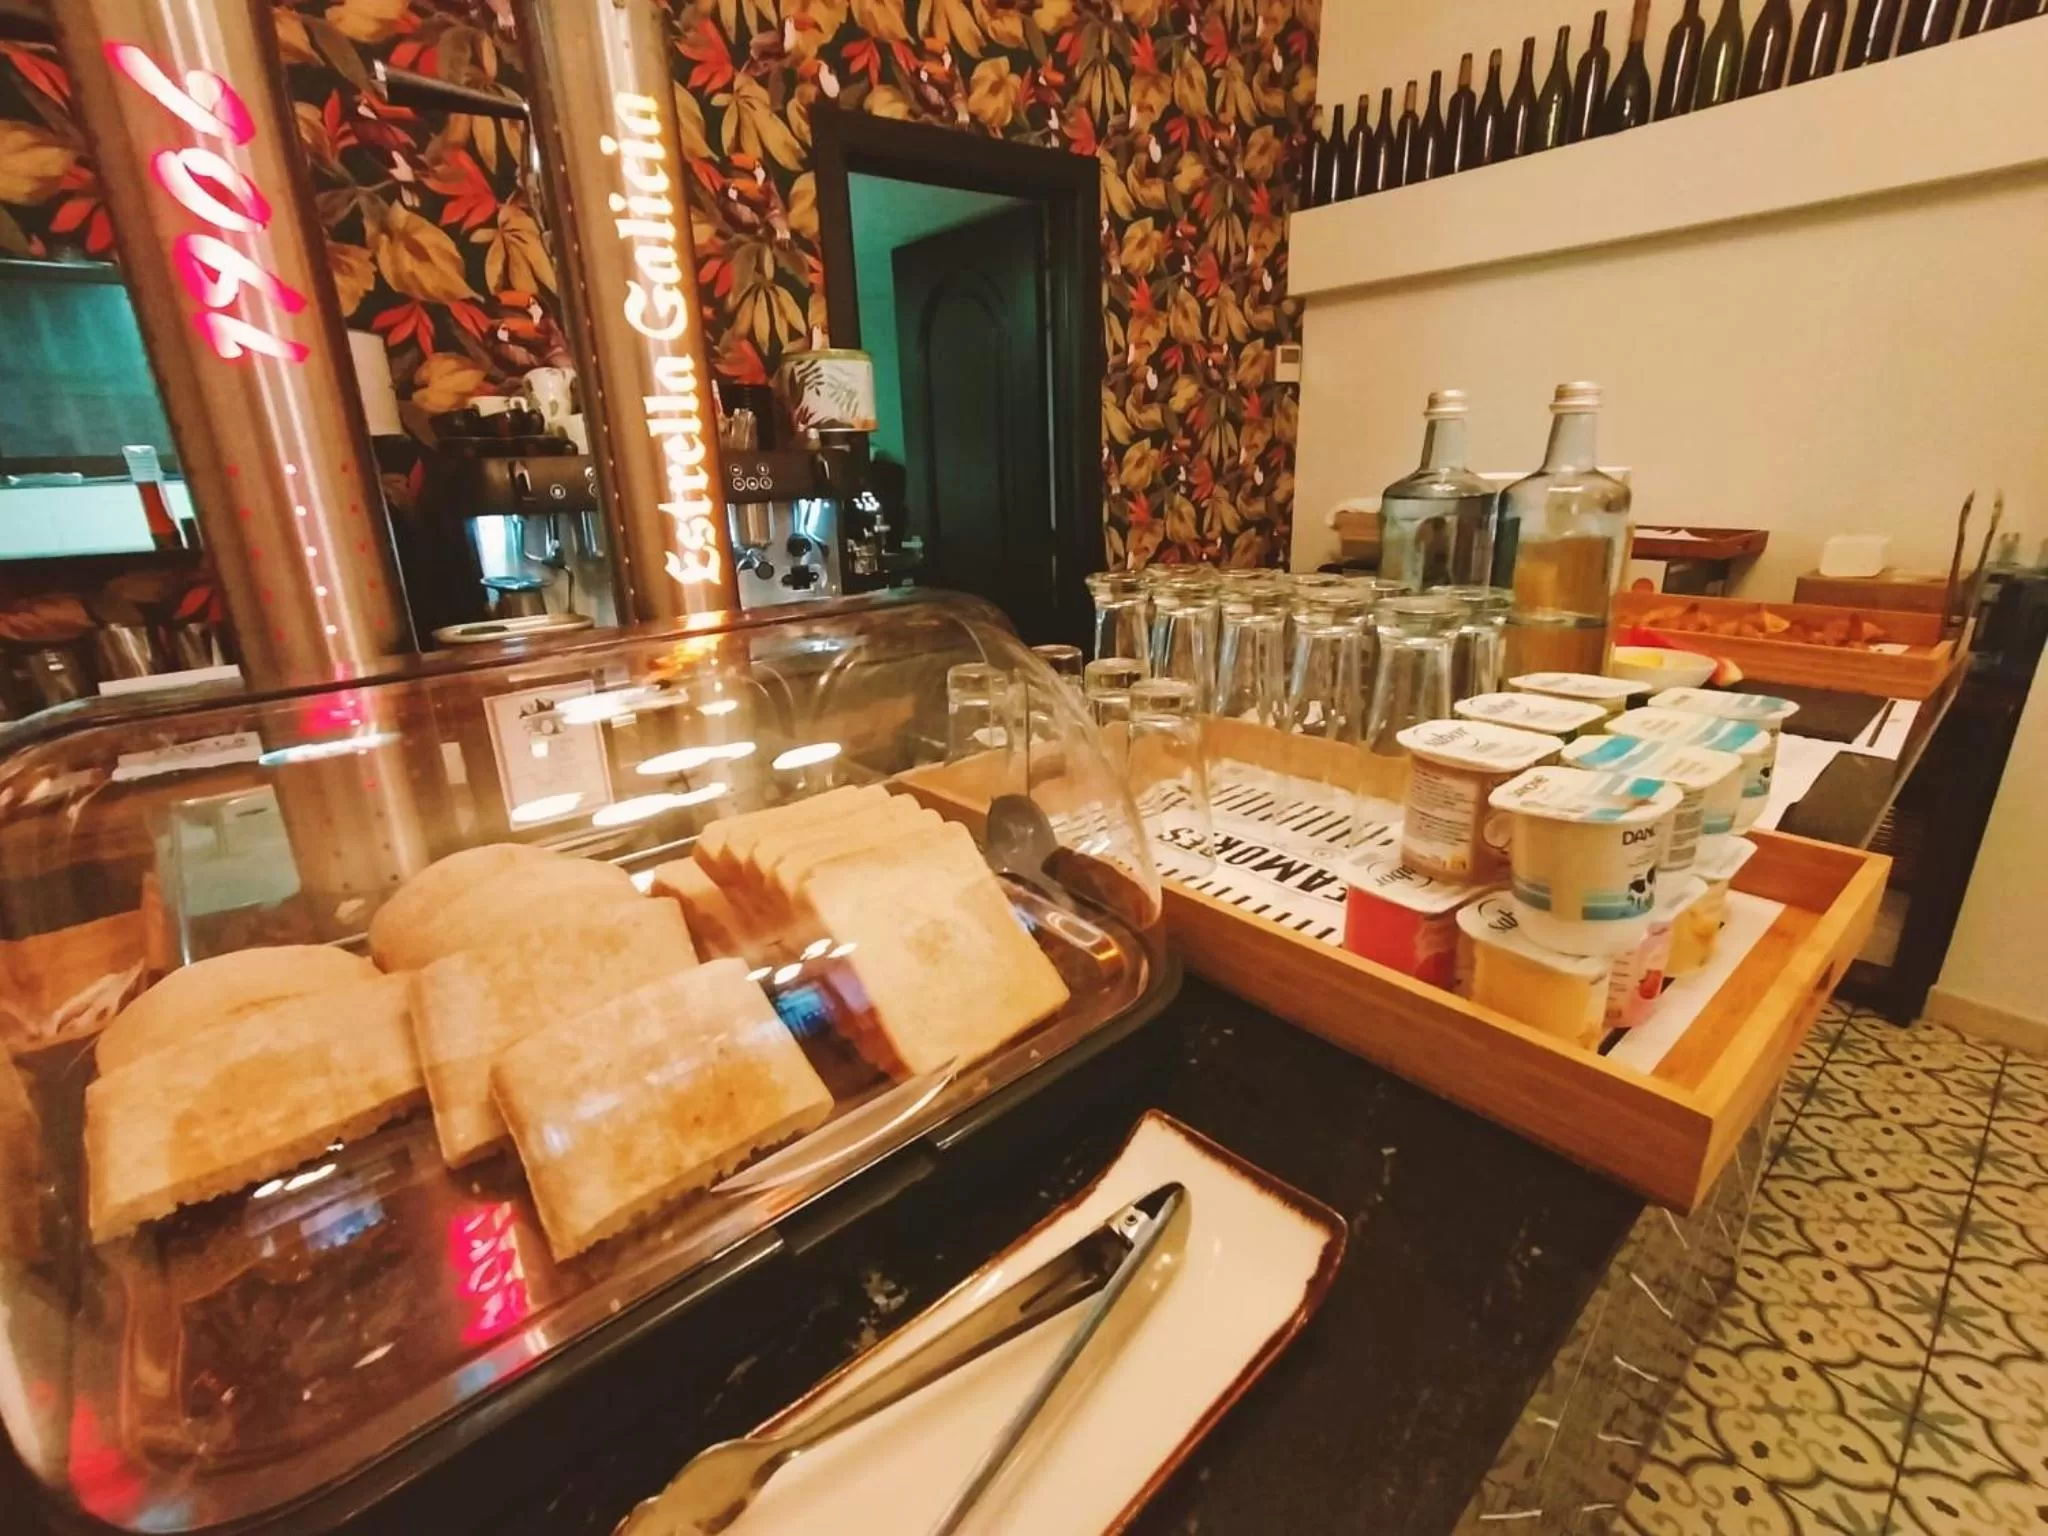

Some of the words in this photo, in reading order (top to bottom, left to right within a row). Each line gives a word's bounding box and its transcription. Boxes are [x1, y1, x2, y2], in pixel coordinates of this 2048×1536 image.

[103, 40, 310, 364] 1906
[600, 91, 688, 341] Galicia
[643, 353, 722, 585] Estrella
